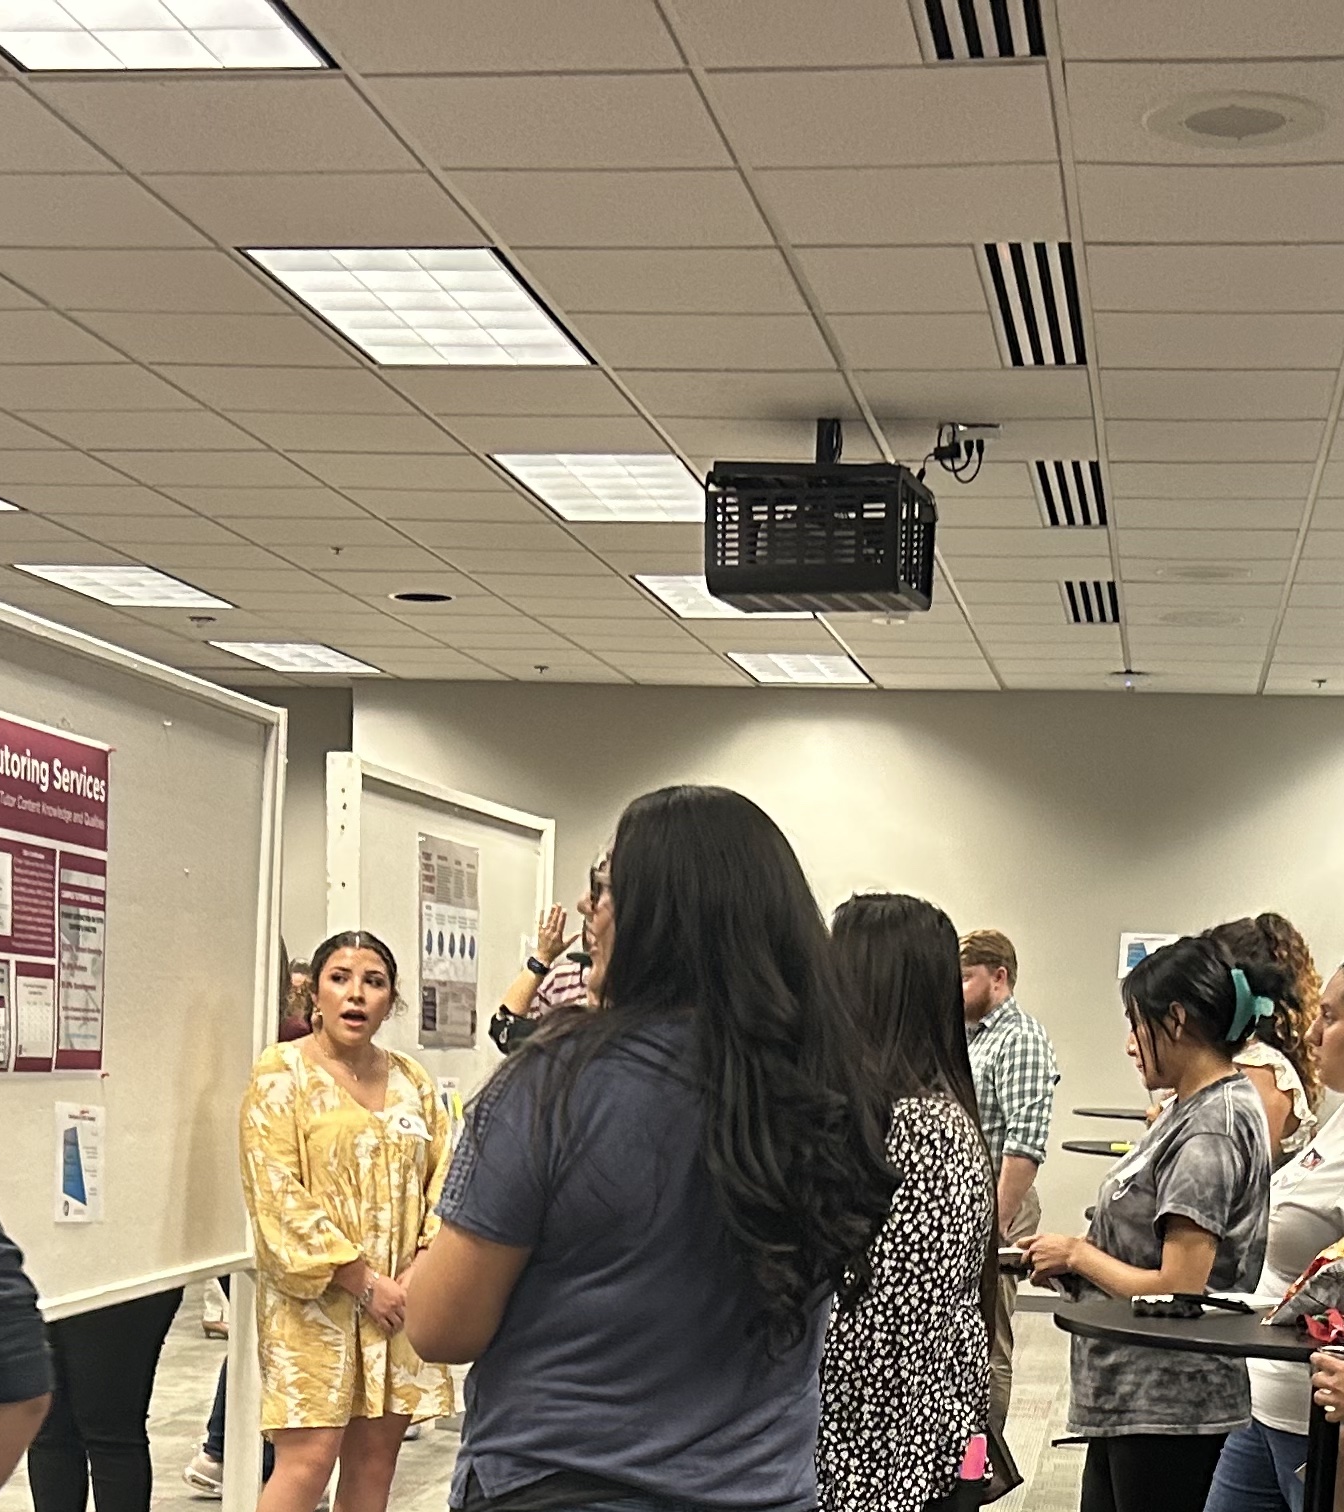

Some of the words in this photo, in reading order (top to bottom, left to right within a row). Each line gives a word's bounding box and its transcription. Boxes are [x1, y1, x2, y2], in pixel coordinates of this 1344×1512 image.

[52, 757, 106, 803] Services
[16, 795, 41, 814] Content
[41, 801, 73, 824] Knowledge
[72, 811, 84, 825] and
